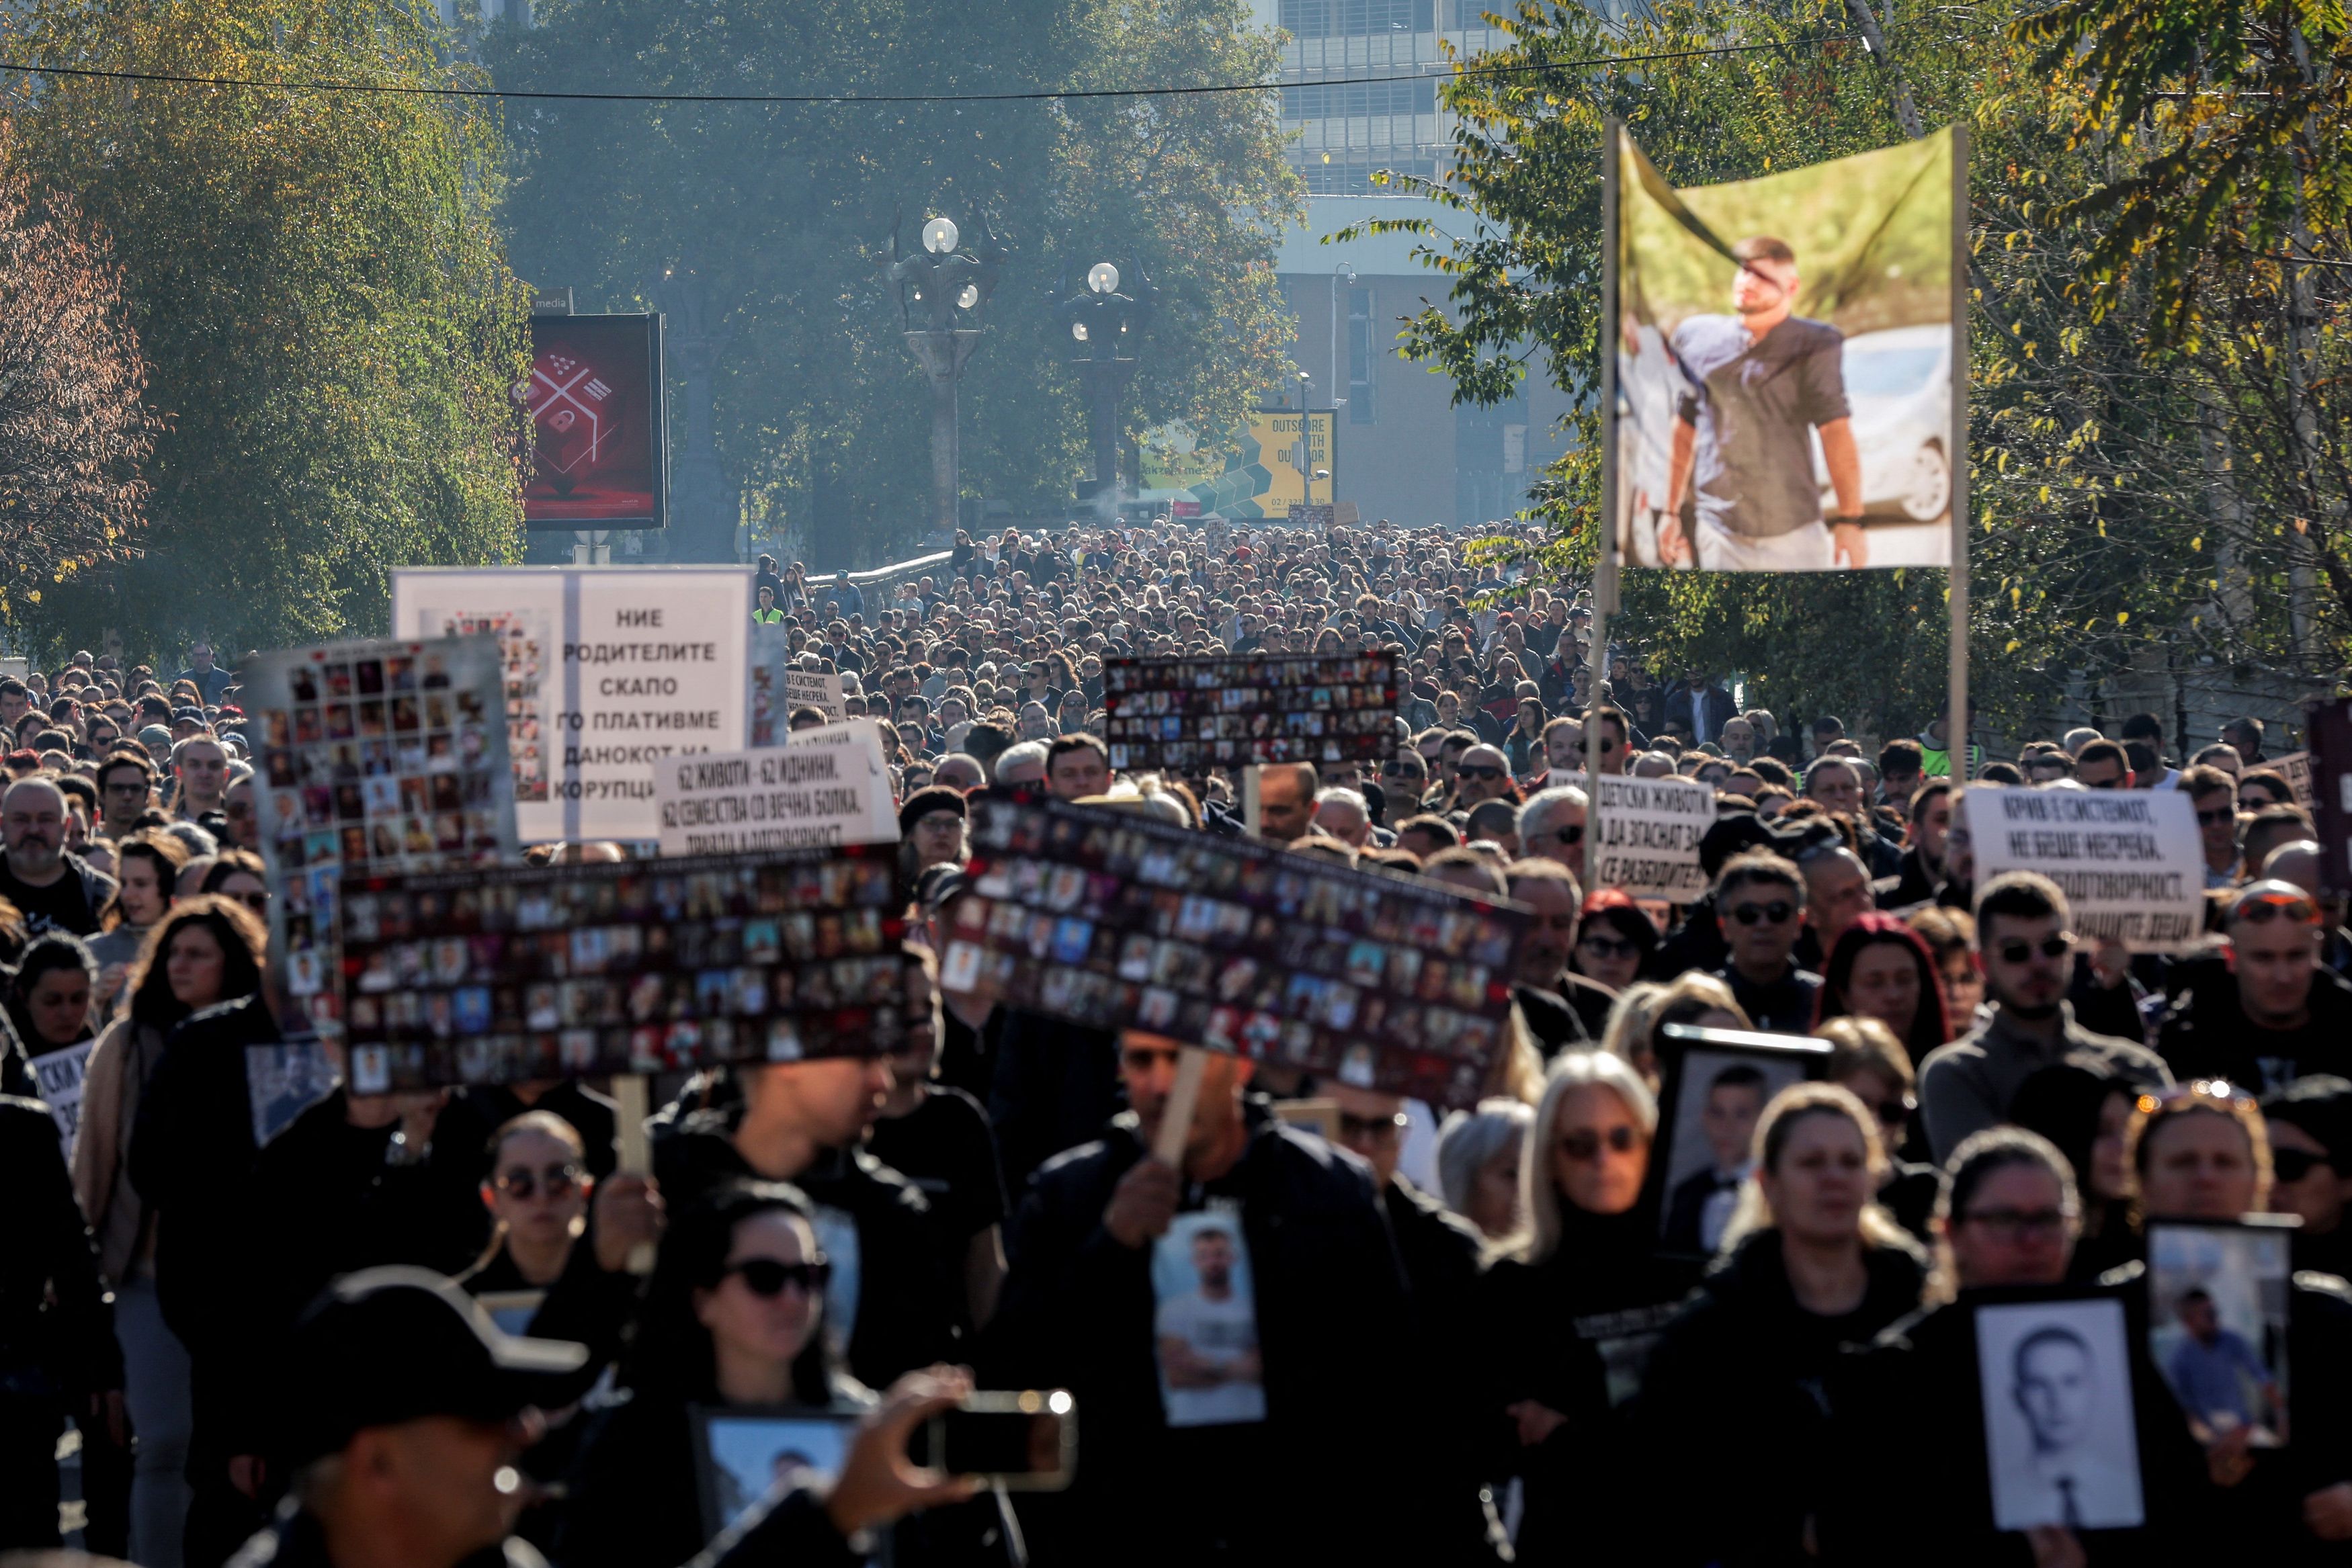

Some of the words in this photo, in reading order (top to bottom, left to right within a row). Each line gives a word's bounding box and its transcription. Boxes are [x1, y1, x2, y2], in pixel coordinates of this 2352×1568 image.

[536, 298, 566, 308] media
[1277, 449, 1325, 462] OUOR
[616, 609, 663, 627] НИЕ
[563, 643, 716, 664] РОДИТЕЛИТЕ
[600, 678, 678, 696] СКАПО
[796, 674, 827, 689] СИСТЕМОТ,
[556, 712, 583, 730] ГО
[593, 711, 719, 730] ПЛАТИВМЕ
[564, 746, 673, 767] ДАНОКОТ
[678, 765, 694, 791] 62
[696, 758, 751, 790] ЖИВОТИ
[760, 756, 777, 785] 62
[1601, 781, 1648, 808] ДЕТСКИ
[663, 801, 679, 828] 62
[770, 790, 812, 820] ВЕЧНА
[2002, 795, 2048, 822] КРИВ
[1607, 818, 1626, 848] ДА
[2007, 830, 2031, 859] НЕ
[2033, 830, 2083, 859] БЕШЕ
[1601, 857, 1618, 884] СЕ
